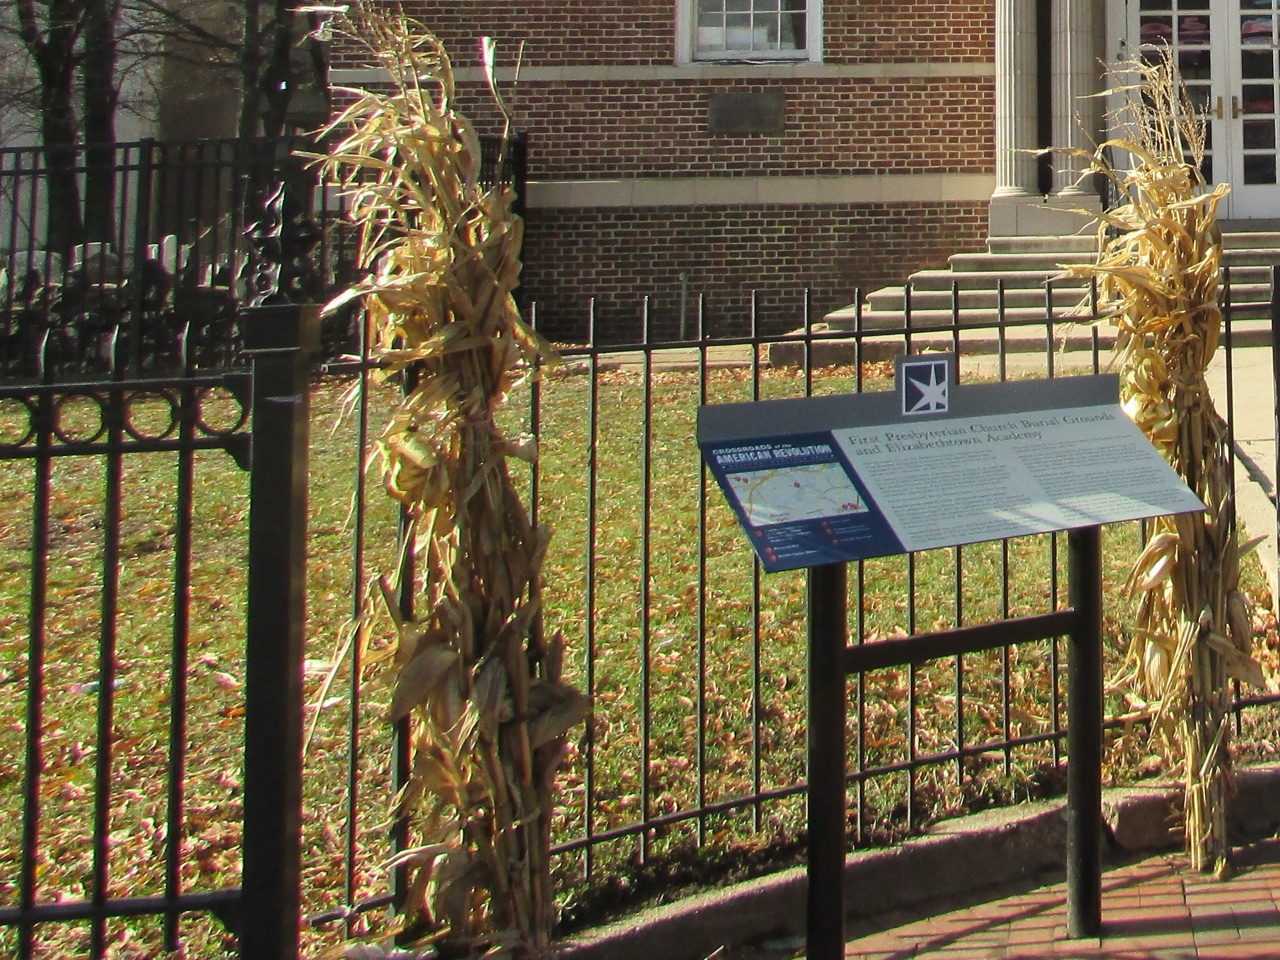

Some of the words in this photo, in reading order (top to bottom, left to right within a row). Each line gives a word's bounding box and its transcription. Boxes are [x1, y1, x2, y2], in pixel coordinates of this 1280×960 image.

[848, 435, 881, 446] First
[885, 426, 967, 443] Presbyterian
[970, 420, 1018, 433] Church
[1021, 417, 1060, 430] Burial
[1063, 411, 1116, 425] Grounds
[712, 444, 772, 455] CROSSROADS
[716, 449, 773, 465] AMERICAN
[773, 444, 832, 458] REVOLUTION
[856, 445, 882, 457] and
[885, 436, 982, 453] Elizabethtown
[987, 429, 1043, 444] Academy
